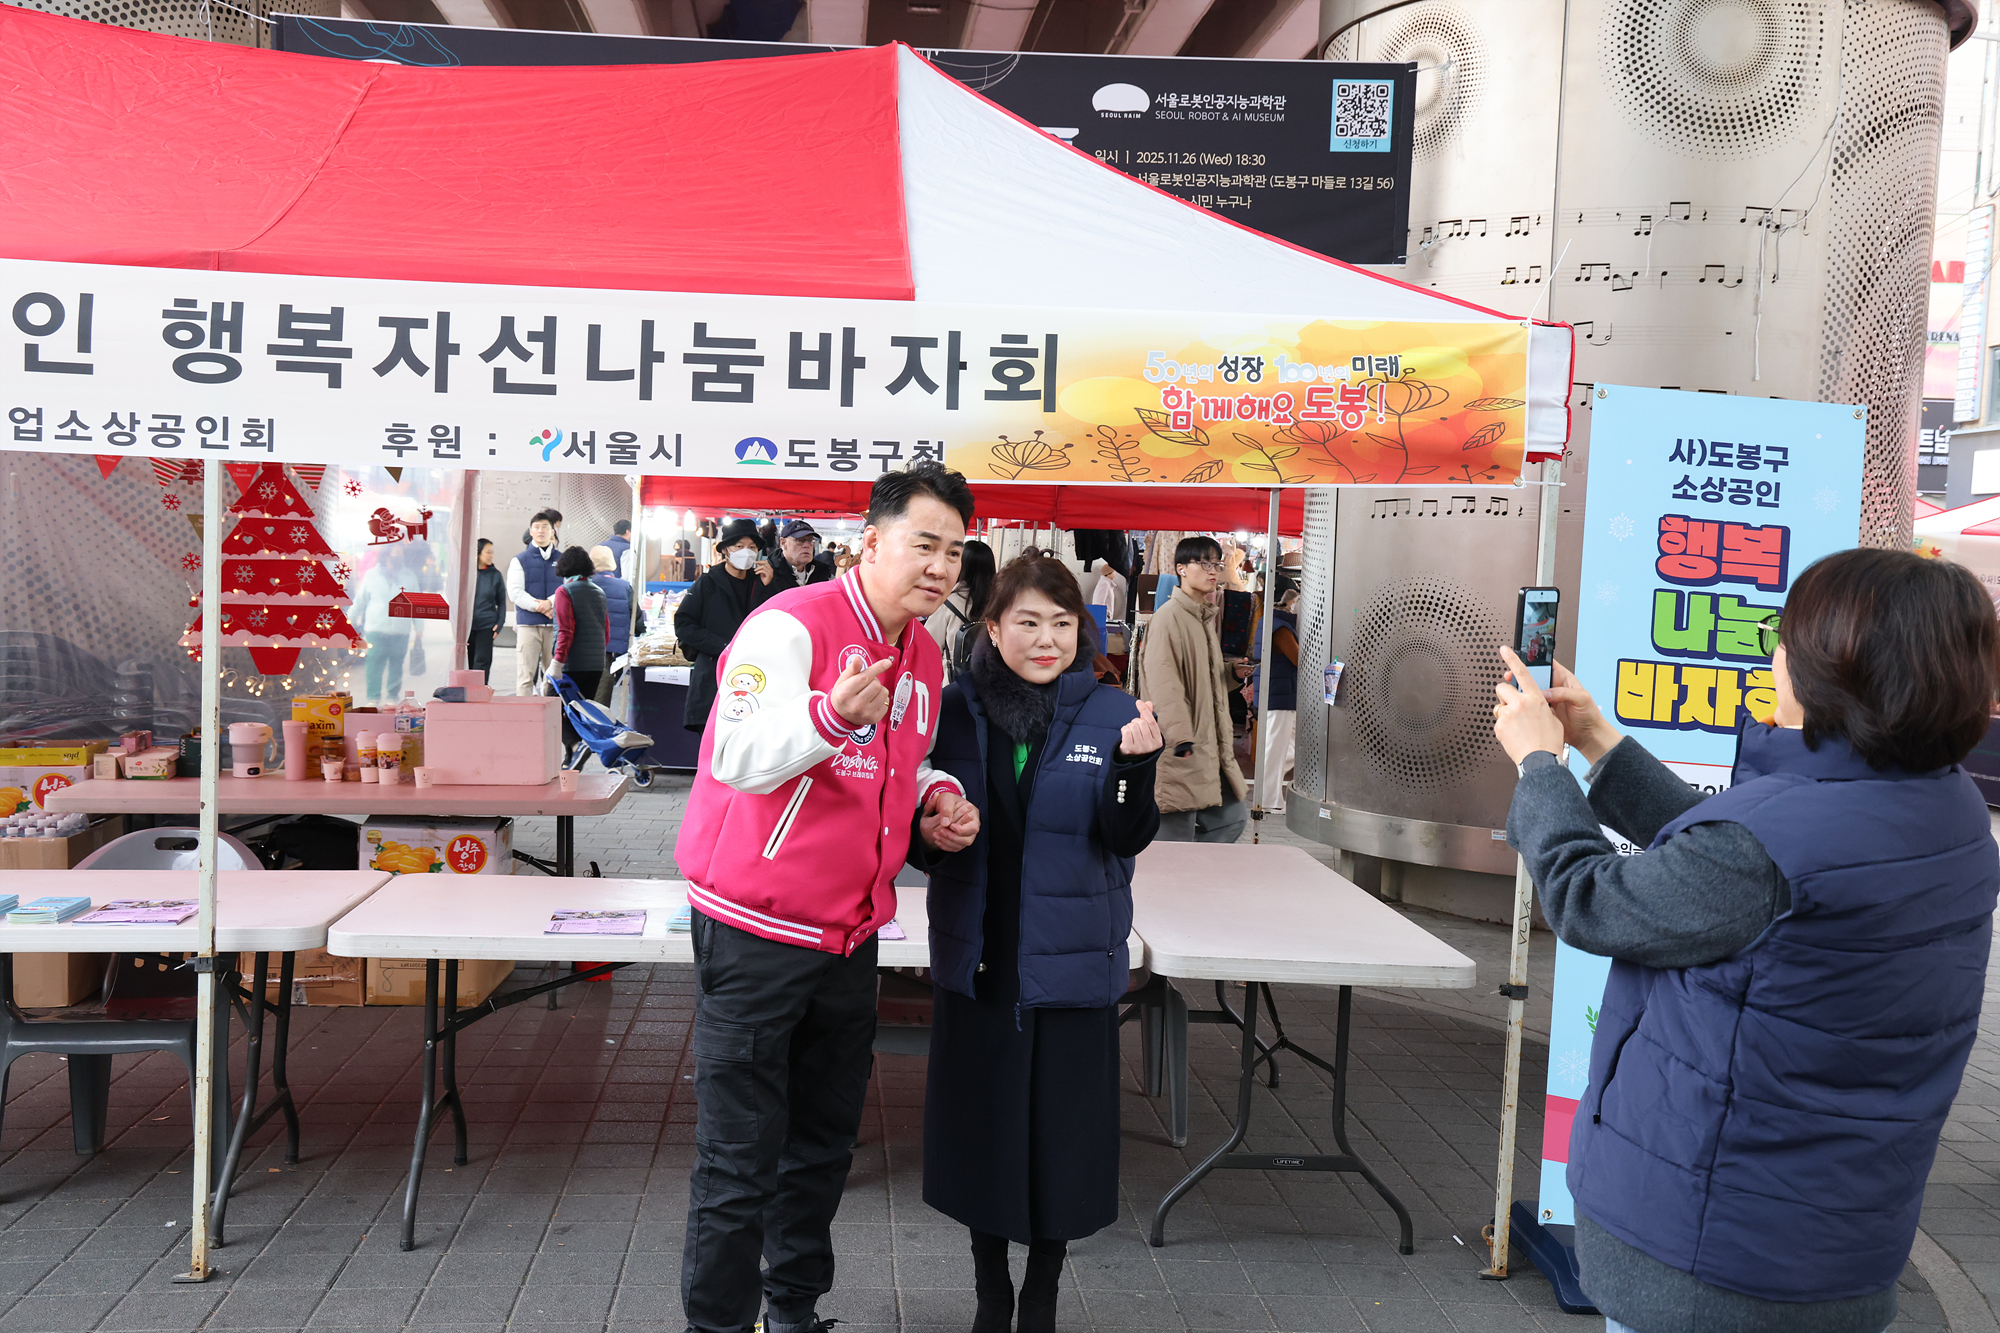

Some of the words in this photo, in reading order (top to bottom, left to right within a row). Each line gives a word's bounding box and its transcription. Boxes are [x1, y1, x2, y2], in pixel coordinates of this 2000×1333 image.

[1155, 92, 1287, 111] 서울로봇인공지능과학관
[1155, 110, 1185, 120] SEOUL
[1188, 111, 1220, 121] ROBOT
[1222, 112, 1229, 121] &
[1232, 112, 1241, 121] AI
[1244, 113, 1285, 122] MUSEUM
[1343, 139, 1378, 149] 신청하기
[1136, 151, 1197, 165] 2025.11.26
[1199, 153, 1233, 166] (Wed)
[1236, 153, 1266, 166] 18:30
[1137, 172, 1268, 189] 서울로봇인공지능과학관
[1270, 175, 1310, 189] (도봉구
[1311, 175, 1347, 190] 마들로
[1350, 176, 1374, 191] 13길
[1376, 177, 1395, 190] 56)
[1216, 195, 1252, 209] 누구나
[12, 291, 95, 375] 인
[162, 297, 1059, 413] 행복자선나눔바자회
[1143, 351, 1215, 384] 50년의
[1217, 354, 1265, 384] 성장
[1272, 353, 1351, 384] 100년의
[1352, 354, 1400, 379] 미래
[1162, 384, 1294, 431] 함께해요
[8, 405, 276, 453] 업소상공인회
[381, 421, 463, 460] 후원
[561, 429, 683, 468] 서울시
[1668, 438, 1790, 474] 사)도봉구
[1671, 474, 1782, 509] 소상공인
[1655, 513, 1791, 593] 행복
[1651, 588, 1784, 665] 나눔
[303, 720, 336, 730] axim
[1065, 753, 1104, 766] 소상공인회
[1074, 744, 1098, 754] 도봉구
[453, 839, 481, 862] 성주
